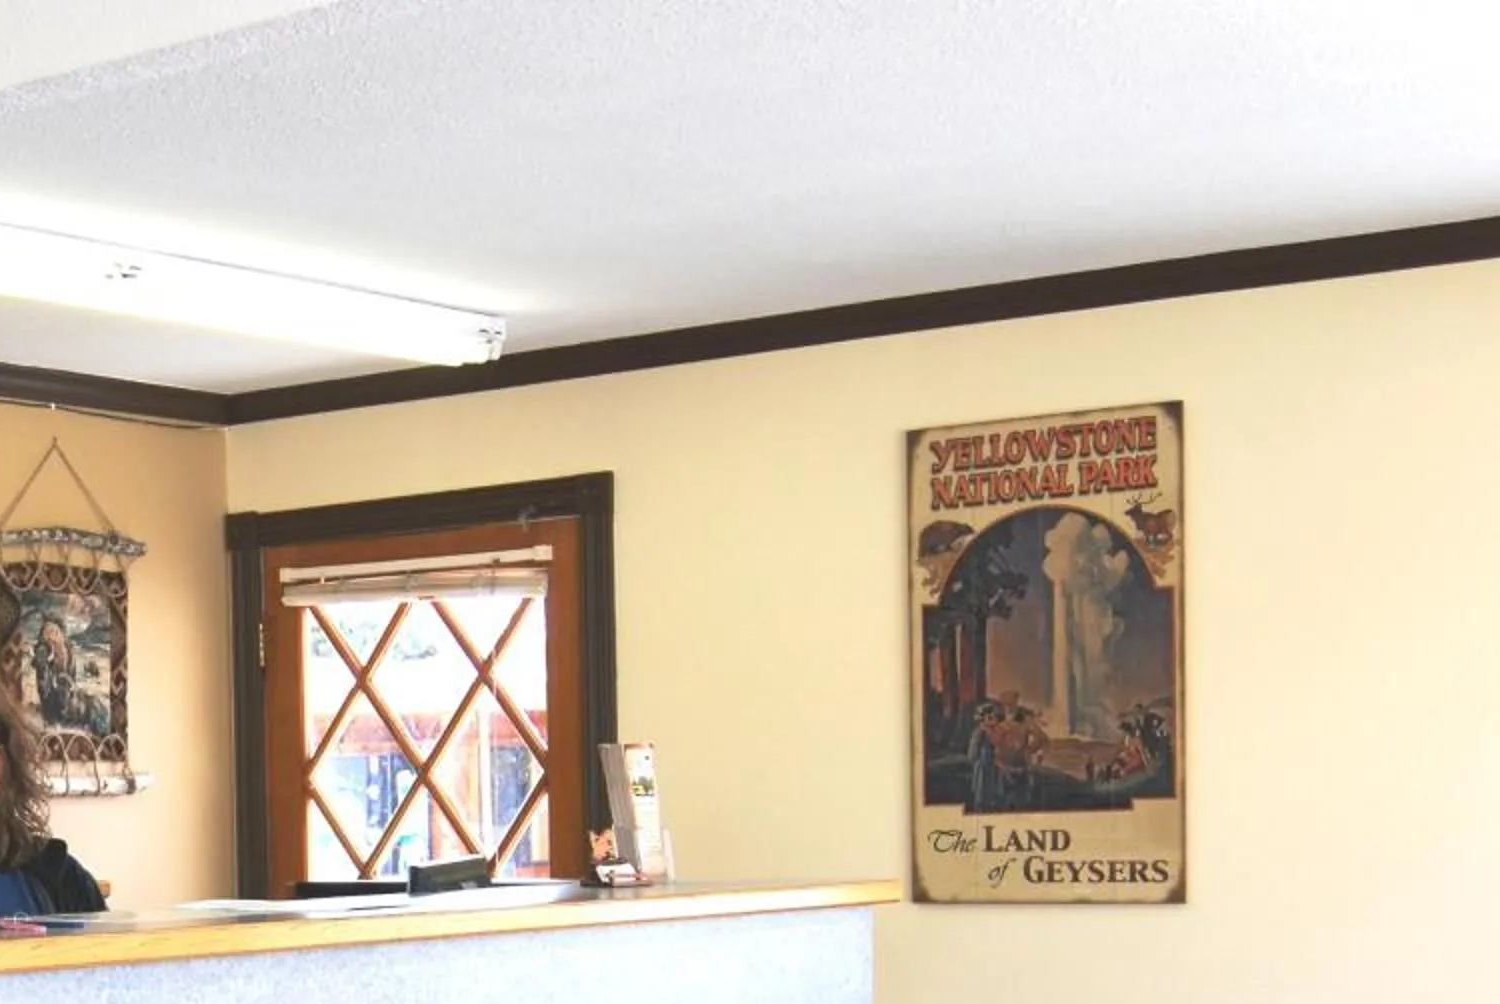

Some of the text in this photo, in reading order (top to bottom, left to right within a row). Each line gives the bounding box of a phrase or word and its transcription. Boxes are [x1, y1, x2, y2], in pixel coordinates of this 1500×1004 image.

[930, 415, 1157, 474] YELLOWSTONE
[930, 454, 1158, 511] NATIONAL PARK
[927, 825, 1071, 854] The LAND
[988, 854, 1169, 890] of GEYSERS
